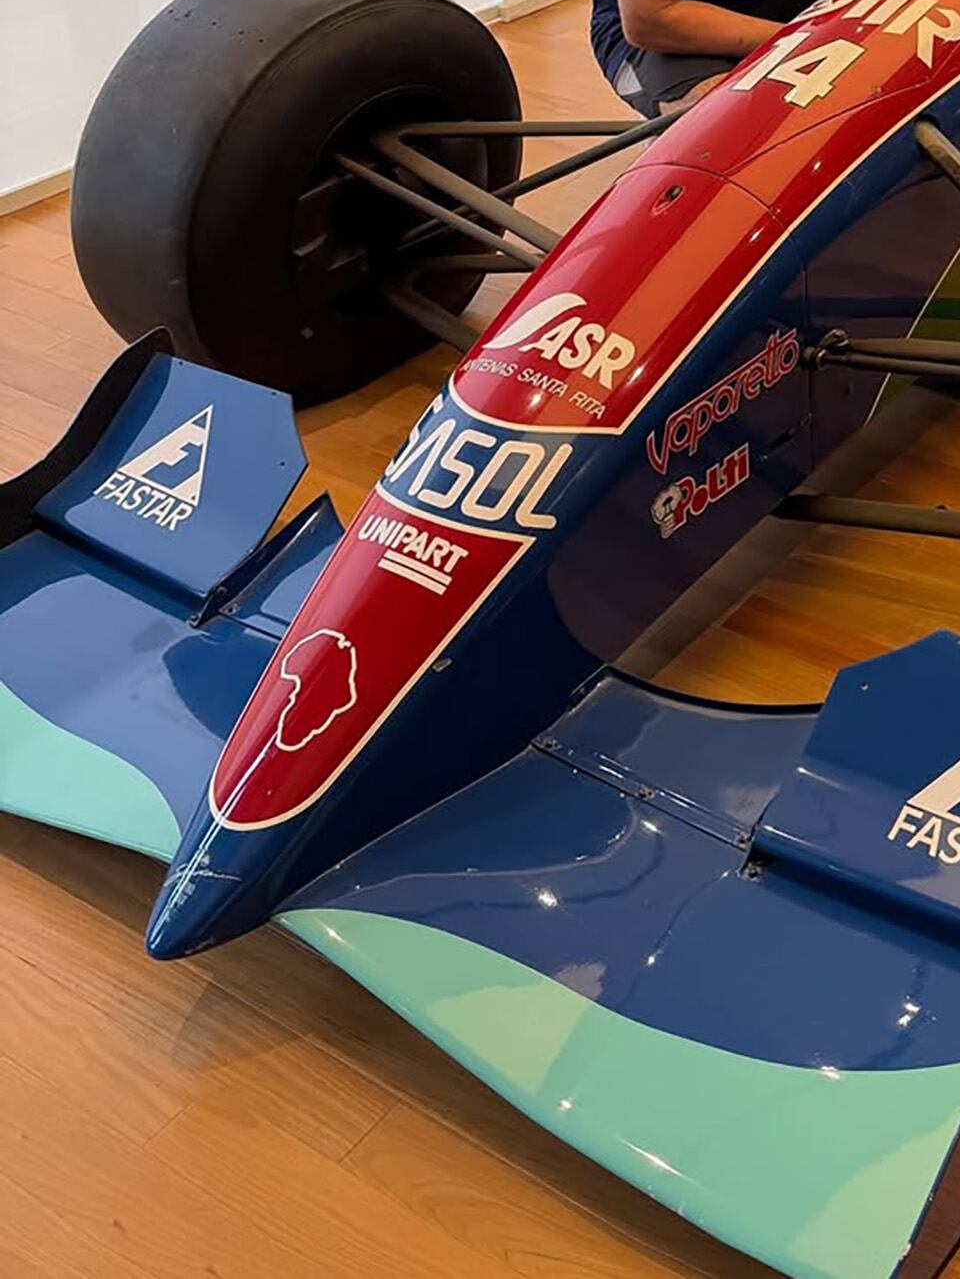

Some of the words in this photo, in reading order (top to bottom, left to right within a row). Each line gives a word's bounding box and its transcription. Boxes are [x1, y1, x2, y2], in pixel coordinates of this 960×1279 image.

[730, 31, 866, 109] 14
[519, 316, 636, 390] ASR
[516, 367, 569, 399] SANTA
[568, 390, 607, 421] RITA
[646, 326, 800, 476] Vaporetto
[384, 392, 573, 530] SASOL
[93, 471, 194, 532] FASTAR
[357, 514, 470, 574] UNIPART
